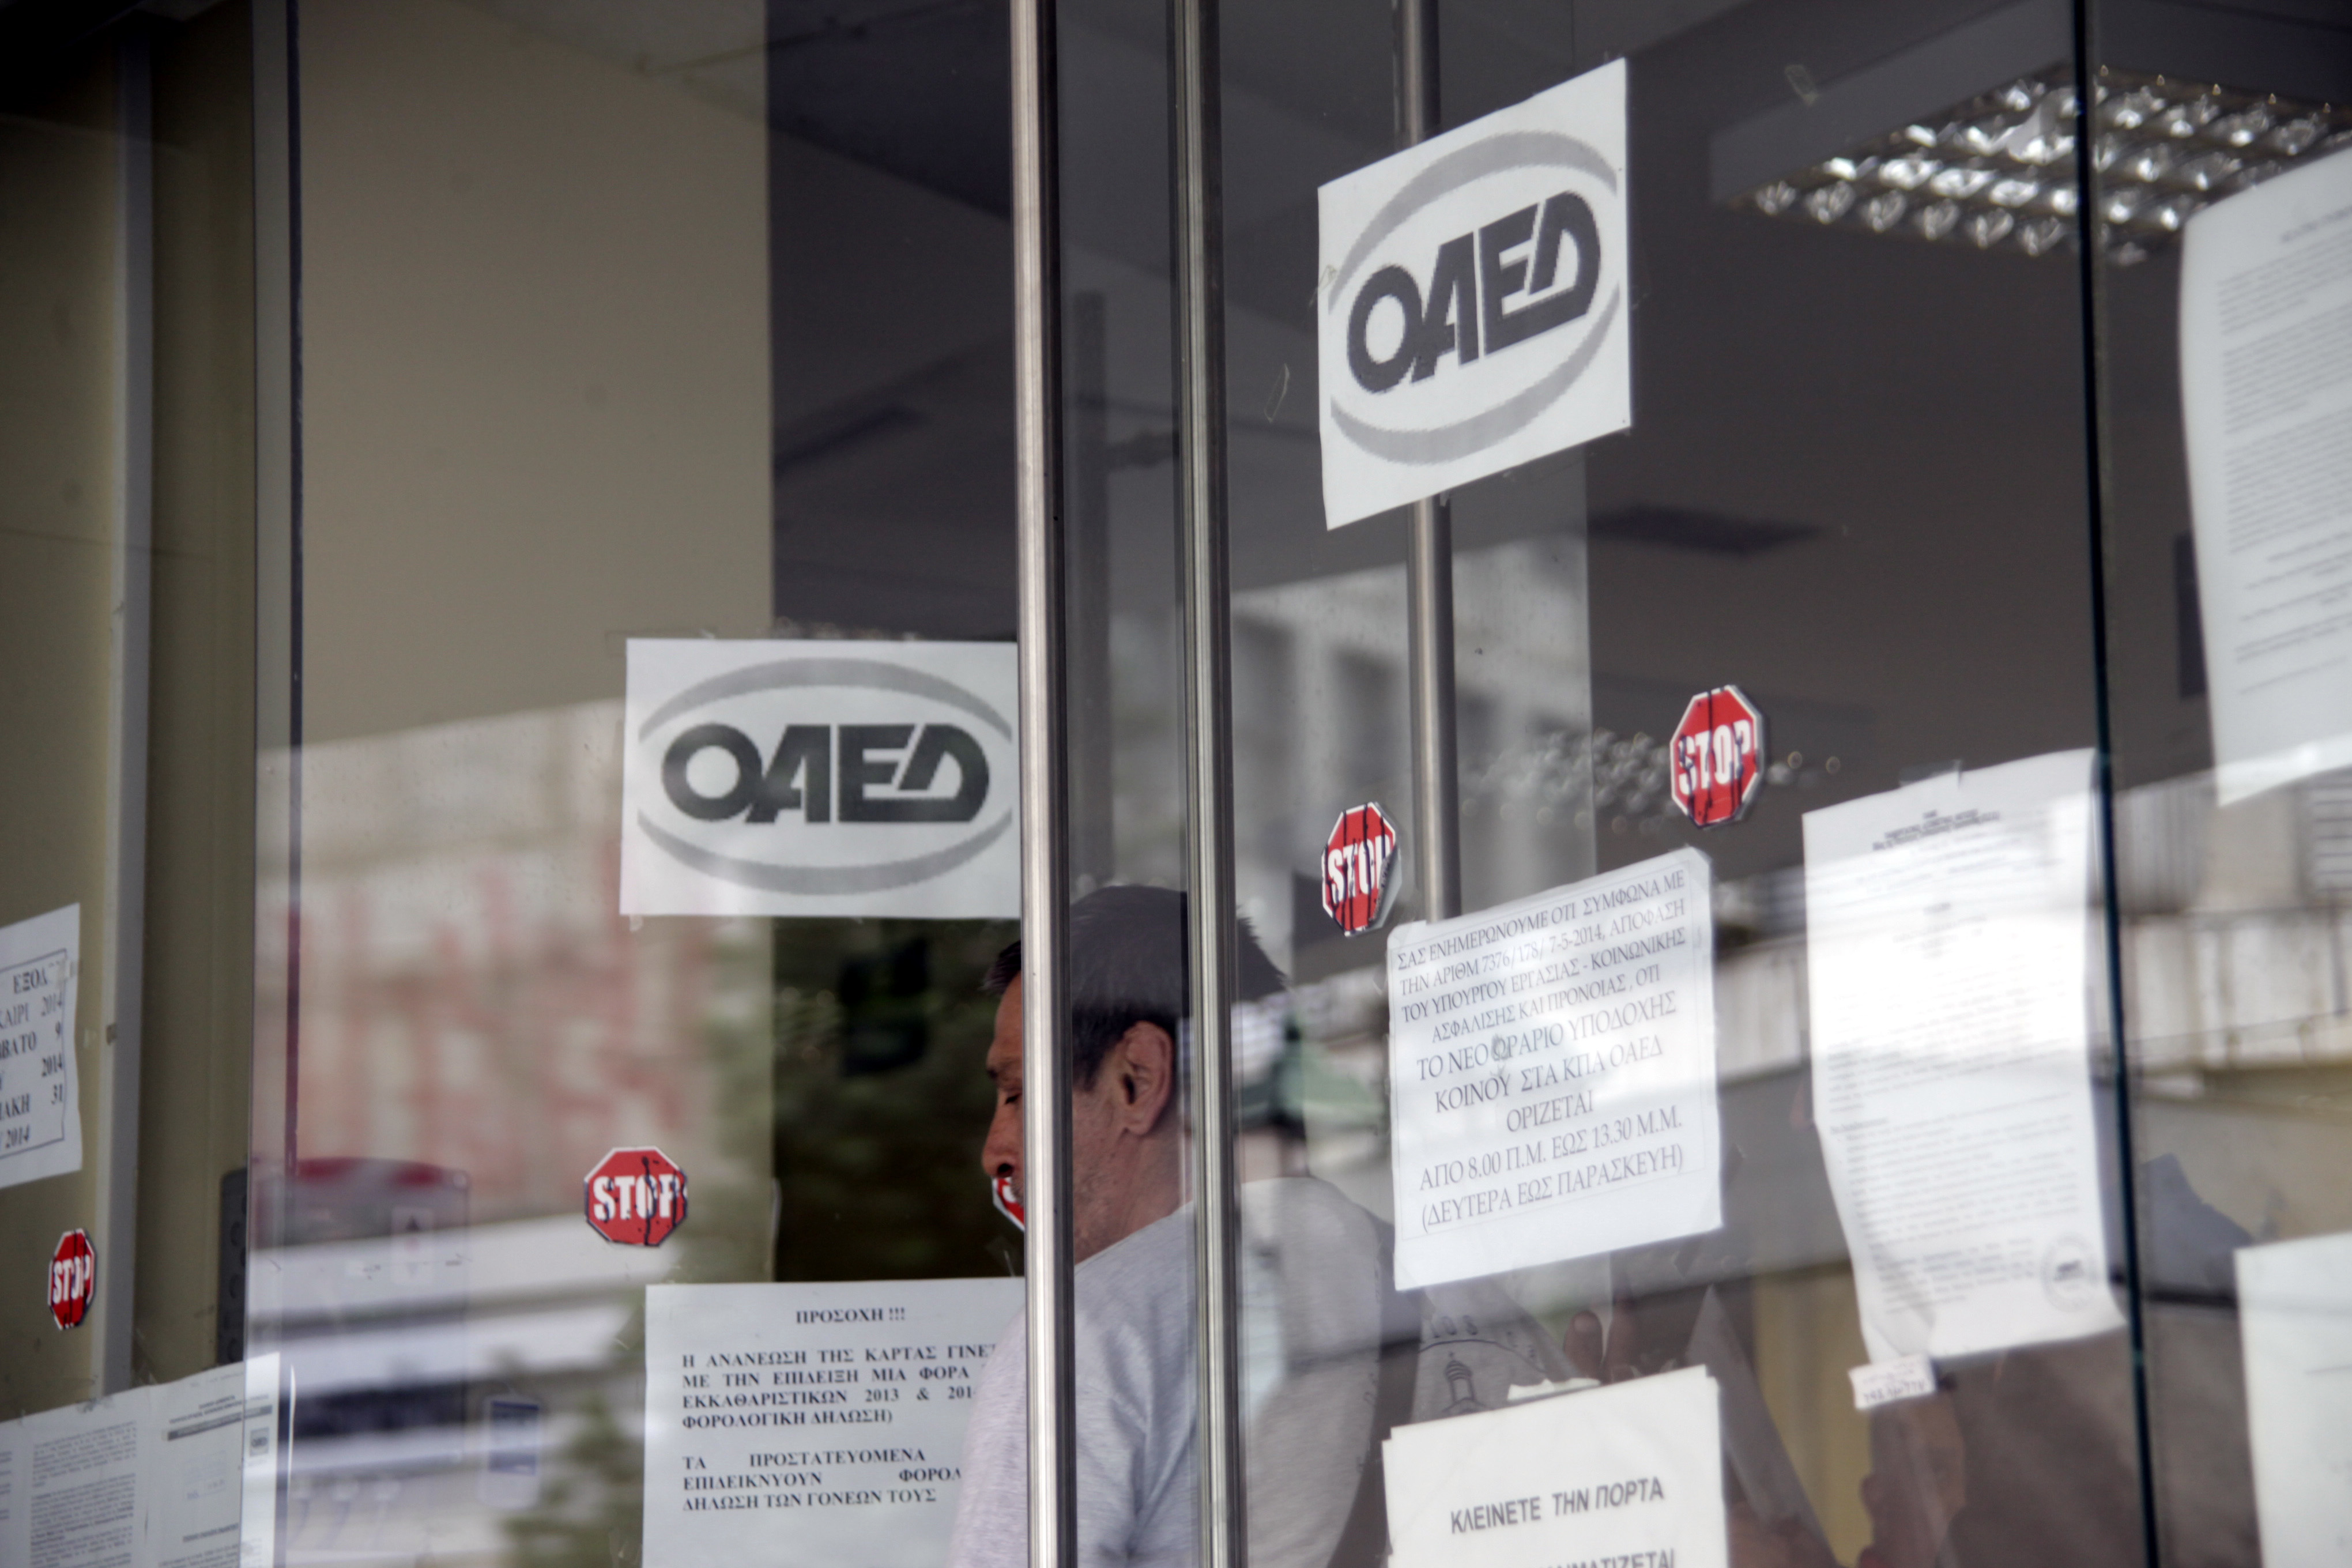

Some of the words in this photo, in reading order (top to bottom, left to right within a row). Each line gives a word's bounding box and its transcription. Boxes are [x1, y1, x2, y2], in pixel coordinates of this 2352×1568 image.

[1678, 719, 1751, 796] STOP
[1397, 947, 1426, 971] ΣΑΣ
[1430, 910, 1548, 962] ΕΝΗΜΕΡΩΝΟΥΜΕ
[1551, 902, 1576, 925] ΟΤΙ
[1583, 879, 1661, 916] ΣΥΜΦΩΝΑ
[1664, 869, 1685, 892] ΜΕ
[1400, 973, 1429, 996] ΤΗΝ
[1433, 958, 1479, 987] ΑΡΙΘΜ
[1610, 898, 1685, 937] ΑΠΟΦΑΣΗ
[1401, 1000, 1428, 1023] ΤΟΥ
[1432, 977, 1506, 1015] ΥΠΟΥΡΓΟΥ
[1510, 958, 1580, 993] ΕΡΓΑΣΙΑΣ
[1590, 926, 1686, 971] ΚΟΙΝΩΝΙΚΗΣ
[41, 991, 63, 1017] 2014
[1432, 1004, 1516, 1044] ΑΣΦΑΛΙΣΗΣ
[1519, 996, 1545, 1019] ΚΑΙ
[1635, 963, 1660, 987] ΟΤΙ
[1416, 1054, 1443, 1081] ΤΟ
[1448, 1043, 1489, 1074] ΝΕΟ
[1492, 1023, 1564, 1061] ΩΡΑΡΙΟ
[1568, 990, 1676, 1041] ΥΠΟΔΟΧΗΣ
[42, 1052, 63, 1077] 2014
[1434, 1073, 1510, 1113] ΚΟΙΝΟΥ
[1521, 1062, 1559, 1092] ΣΤΑ
[1563, 1050, 1606, 1081] ΚΠΑ
[1610, 1034, 1663, 1068] ΟΑΕΔ
[1506, 1090, 1594, 1132] ΟΡΙΖΕΤΑΙ
[5, 1124, 30, 1148] 2014
[1420, 1160, 1464, 1191] ΑΠΟ
[1468, 1151, 1501, 1179] 8.00
[1506, 1141, 1547, 1171] Π.Μ.
[1551, 1129, 1588, 1160] ΕΩΣ
[1592, 1116, 1632, 1149] 13.30
[1637, 1104, 1683, 1137] Μ.Μ.
[593, 1174, 681, 1222] STOP
[1422, 1187, 1512, 1234] (ΔΕΥΤΕΡΑ
[1518, 1175, 1553, 1206] ΕΩΣ
[1558, 1143, 1683, 1196] ΠΑΡΑΣΚΕΥΗ)
[52, 1254, 91, 1304] STOP
[796, 1308, 884, 1324] ΠΡΟΣΟΧΗ
[681, 1354, 695, 1369] Η
[706, 1350, 807, 1367] ΑΝΑΝΕΩΣΗ
[817, 1348, 854, 1363] ΤΗΣ
[865, 1345, 937, 1362] ΚΑΡΤΑΣ
[682, 1374, 710, 1389] ΜΕ
[722, 1372, 760, 1388] ΤΗΝ
[773, 1368, 859, 1385] ΕΠΙΔΕΙΞΗ
[872, 1367, 907, 1382] ΜΙΑ
[919, 1365, 970, 1381] ΦΟΡΑ
[682, 1411, 806, 1429] ΦΟΡΟΛΟΓΙΚΗ
[811, 1408, 893, 1424] ΔΗΛΩΣΗ)
[683, 1390, 848, 1409] ΕΚΚΑΘΑΡΙΣΤΙΚΩΝ
[865, 1388, 900, 1403] 2013
[916, 1387, 930, 1401] &
[948, 1385, 976, 1400] 201
[682, 1456, 707, 1471] ΤΑ
[749, 1448, 925, 1468] ΠΡΟΣΤΑΤΕΥΟΜΕΝΑ
[683, 1471, 823, 1491] ΕΠΙΔΕΙΚΝΥΟΥΝ
[683, 1495, 759, 1511] ΔΗΛΩΣΗ
[764, 1492, 802, 1508] ΤΩΝ
[807, 1490, 883, 1507] ΓΟΝΕΩΝ
[887, 1488, 937, 1504] ΤΟΥΣ
[1450, 1496, 1541, 1535] ΚΛΕΙΝΕΤΕ
[1552, 1487, 1589, 1517] ΤΗΝ
[1596, 1476, 1664, 1510] ΠΟΡΤΑ
